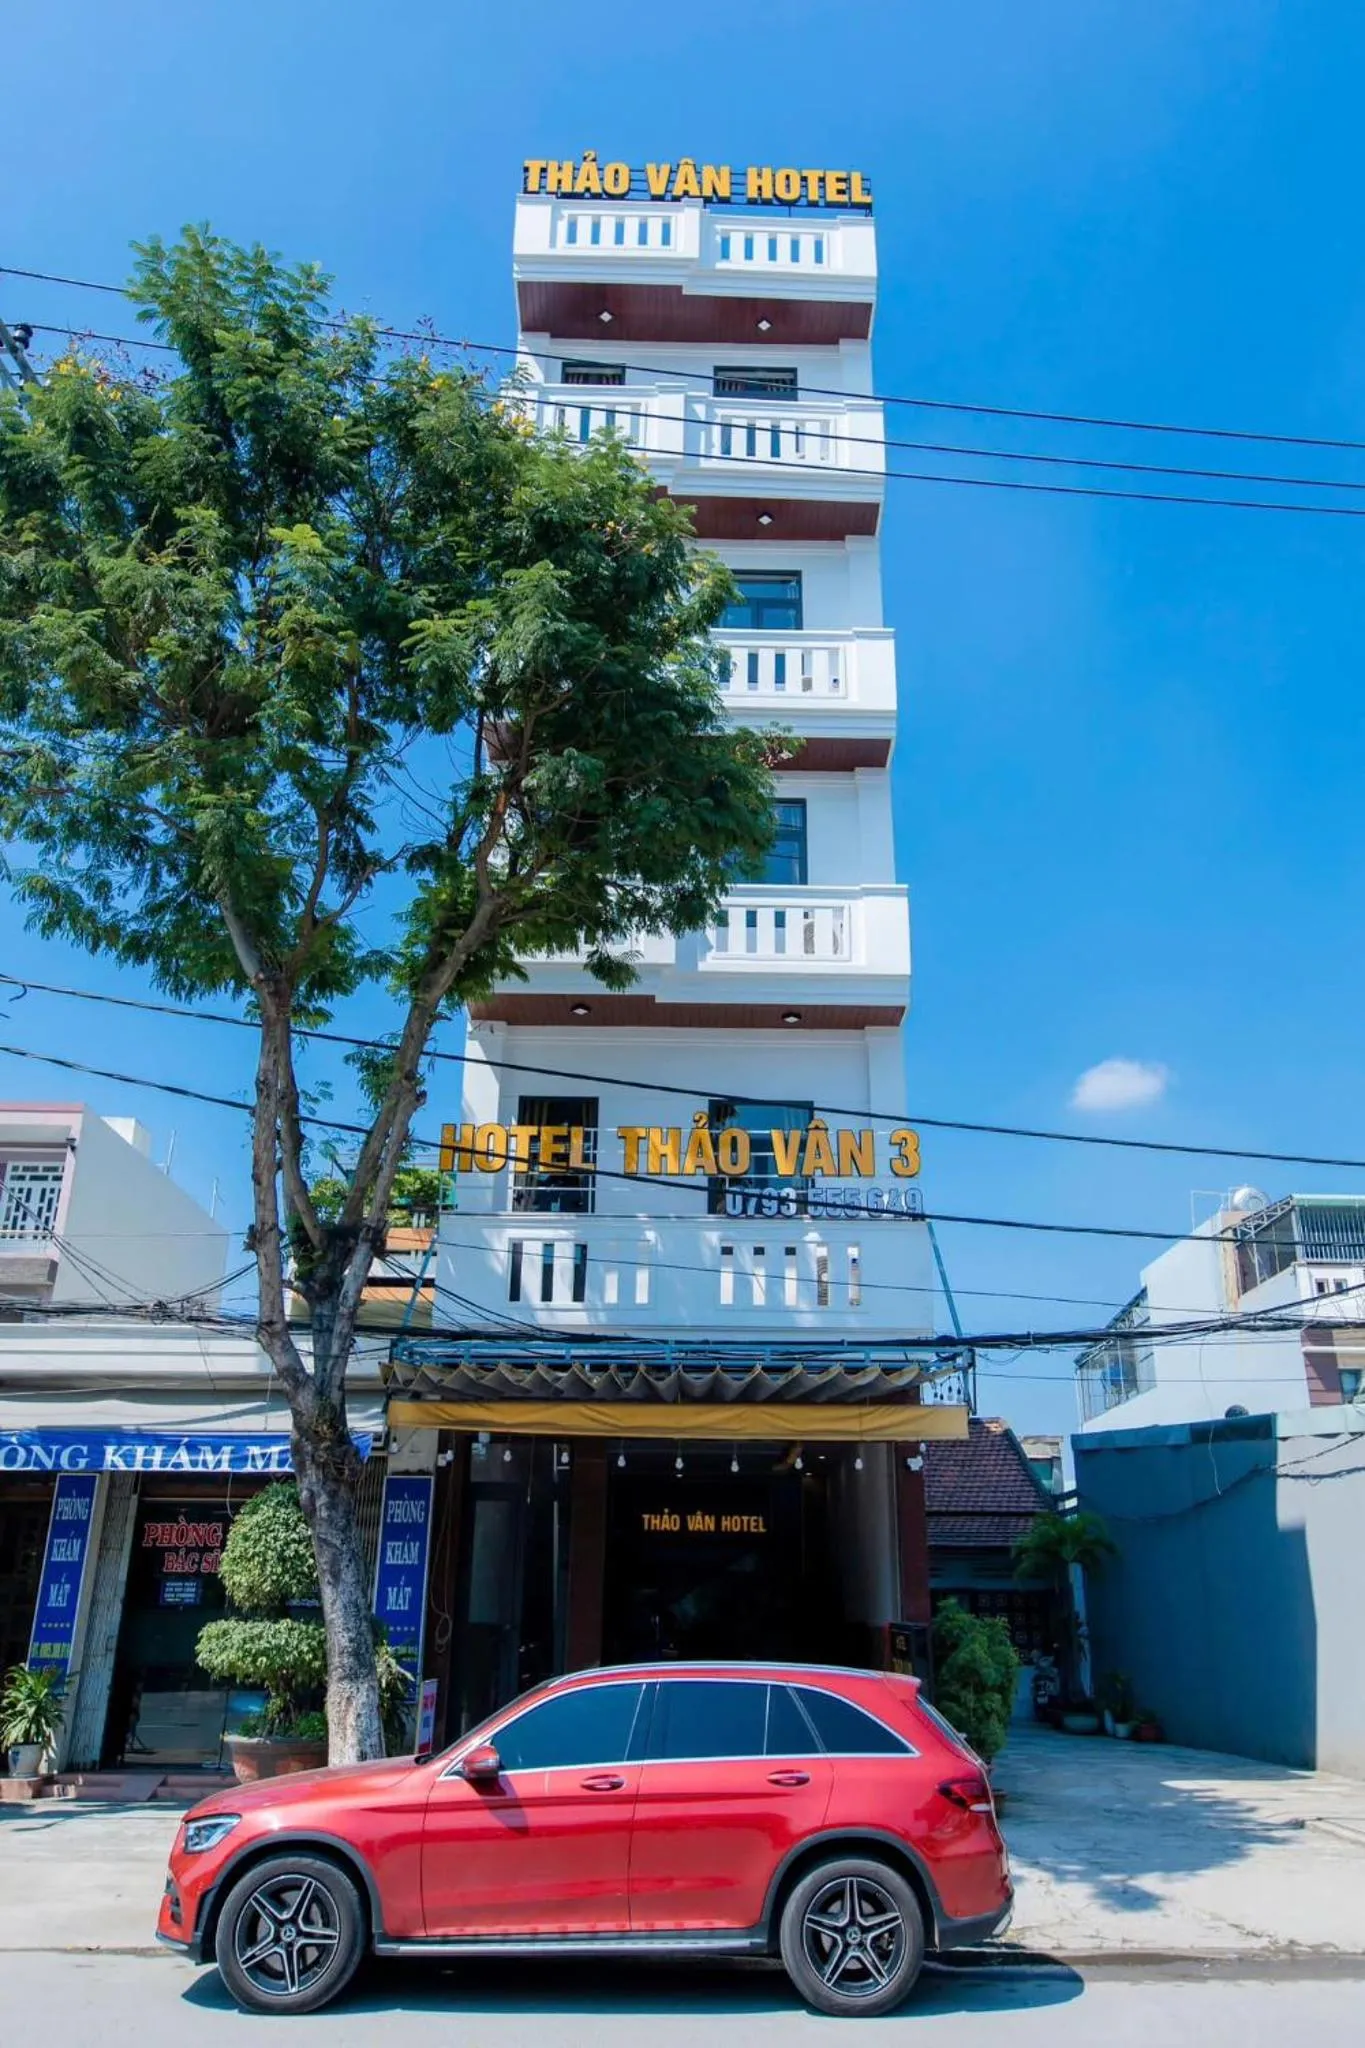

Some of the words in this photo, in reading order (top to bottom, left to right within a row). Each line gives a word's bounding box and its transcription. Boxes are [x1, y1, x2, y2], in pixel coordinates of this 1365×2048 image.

[524, 151, 630, 196] THẢO
[646, 158, 731, 200] VÂN
[747, 167, 873, 205] HOTEL
[439, 1123, 596, 1174] HOTEL
[616, 1112, 750, 1176] THẢO
[770, 1120, 875, 1178] VÂN
[889, 1129, 922, 1178] 3
[726, 1187, 797, 1218] 0793
[102, 1438, 233, 1471] KHÁM
[56, 1489, 90, 1520] PHÒNG
[386, 1492, 425, 1523] PHÒNG
[642, 1507, 680, 1531] THẢO
[686, 1510, 715, 1532] VÂN
[721, 1515, 767, 1532] HOTEL
[51, 1530, 81, 1562] KHÁM
[142, 1514, 223, 1547] PHÒNG
[163, 1547, 200, 1573] BÁC
[386, 1532, 420, 1565] KHÁM
